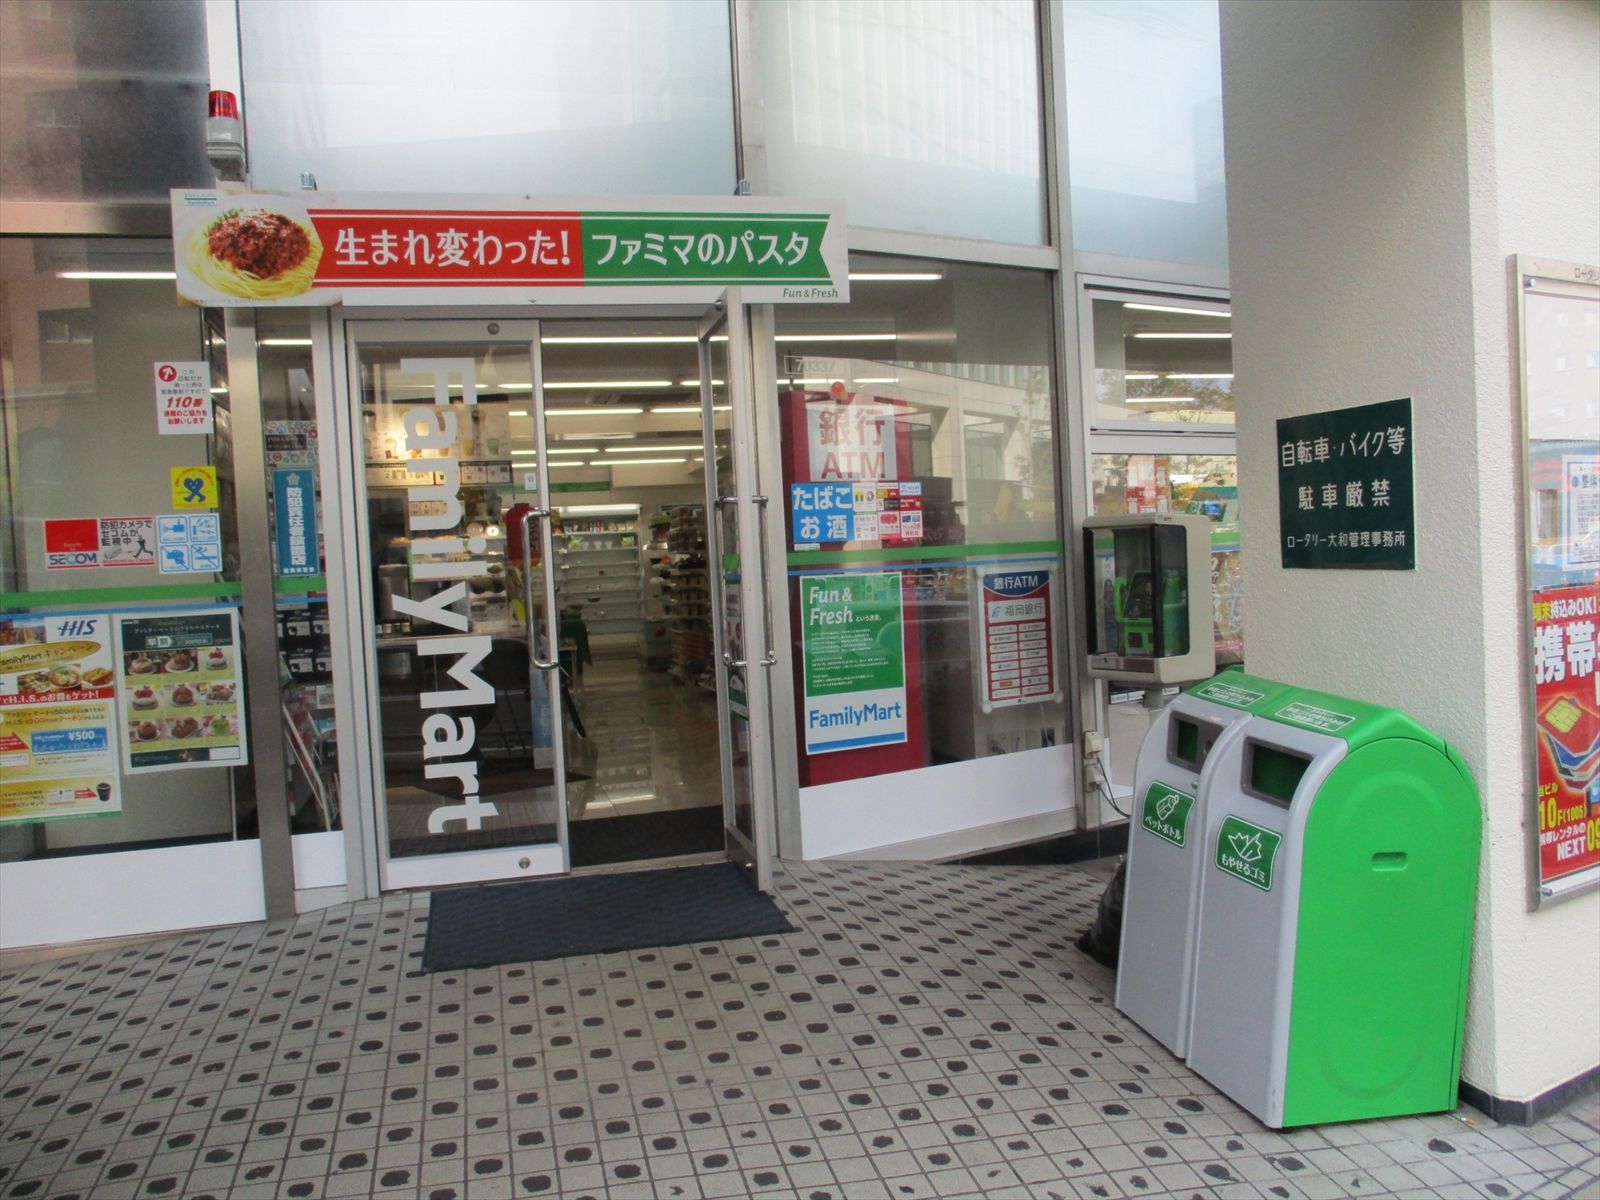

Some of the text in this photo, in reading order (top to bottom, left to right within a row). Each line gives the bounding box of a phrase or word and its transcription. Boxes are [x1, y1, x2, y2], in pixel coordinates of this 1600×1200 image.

[335, 228, 570, 267] 生まれ変わった!
[592, 230, 809, 266] ファミマのパスタ
[783, 288, 801, 298] Fun
[811, 288, 839, 299] Fresh
[167, 396, 204, 409] 110番
[819, 408, 886, 447] 銀行
[1281, 425, 1406, 468] 自転車・バイク等
[821, 451, 886, 479] ATM
[793, 486, 853, 510] たばこ
[1298, 478, 1391, 510] 駐車厳禁
[100, 521, 153, 530] 防犯カメラで
[101, 529, 139, 538] セコムが
[800, 514, 848, 539] お酒
[102, 537, 132, 546] 監視中
[1287, 529, 1406, 548] ロータリー大和管理事務所
[49, 552, 97, 565] SECOM
[391, 356, 499, 834] FamilyMart
[994, 575, 1039, 591] 銀行ATM
[809, 586, 854, 605] Fun &
[809, 605, 854, 626] Fresh
[57, 619, 97, 637] HIS
[0, 652, 42, 666] amilyMart
[1534, 620, 1600, 684] 携帯
[809, 701, 902, 729] FamilyMart
[68, 730, 96, 741] ¥500
[1144, 815, 1182, 841] ペットボトル
[1557, 836, 1586, 861] NEXT
[1221, 852, 1266, 883] もやせるゴミ
